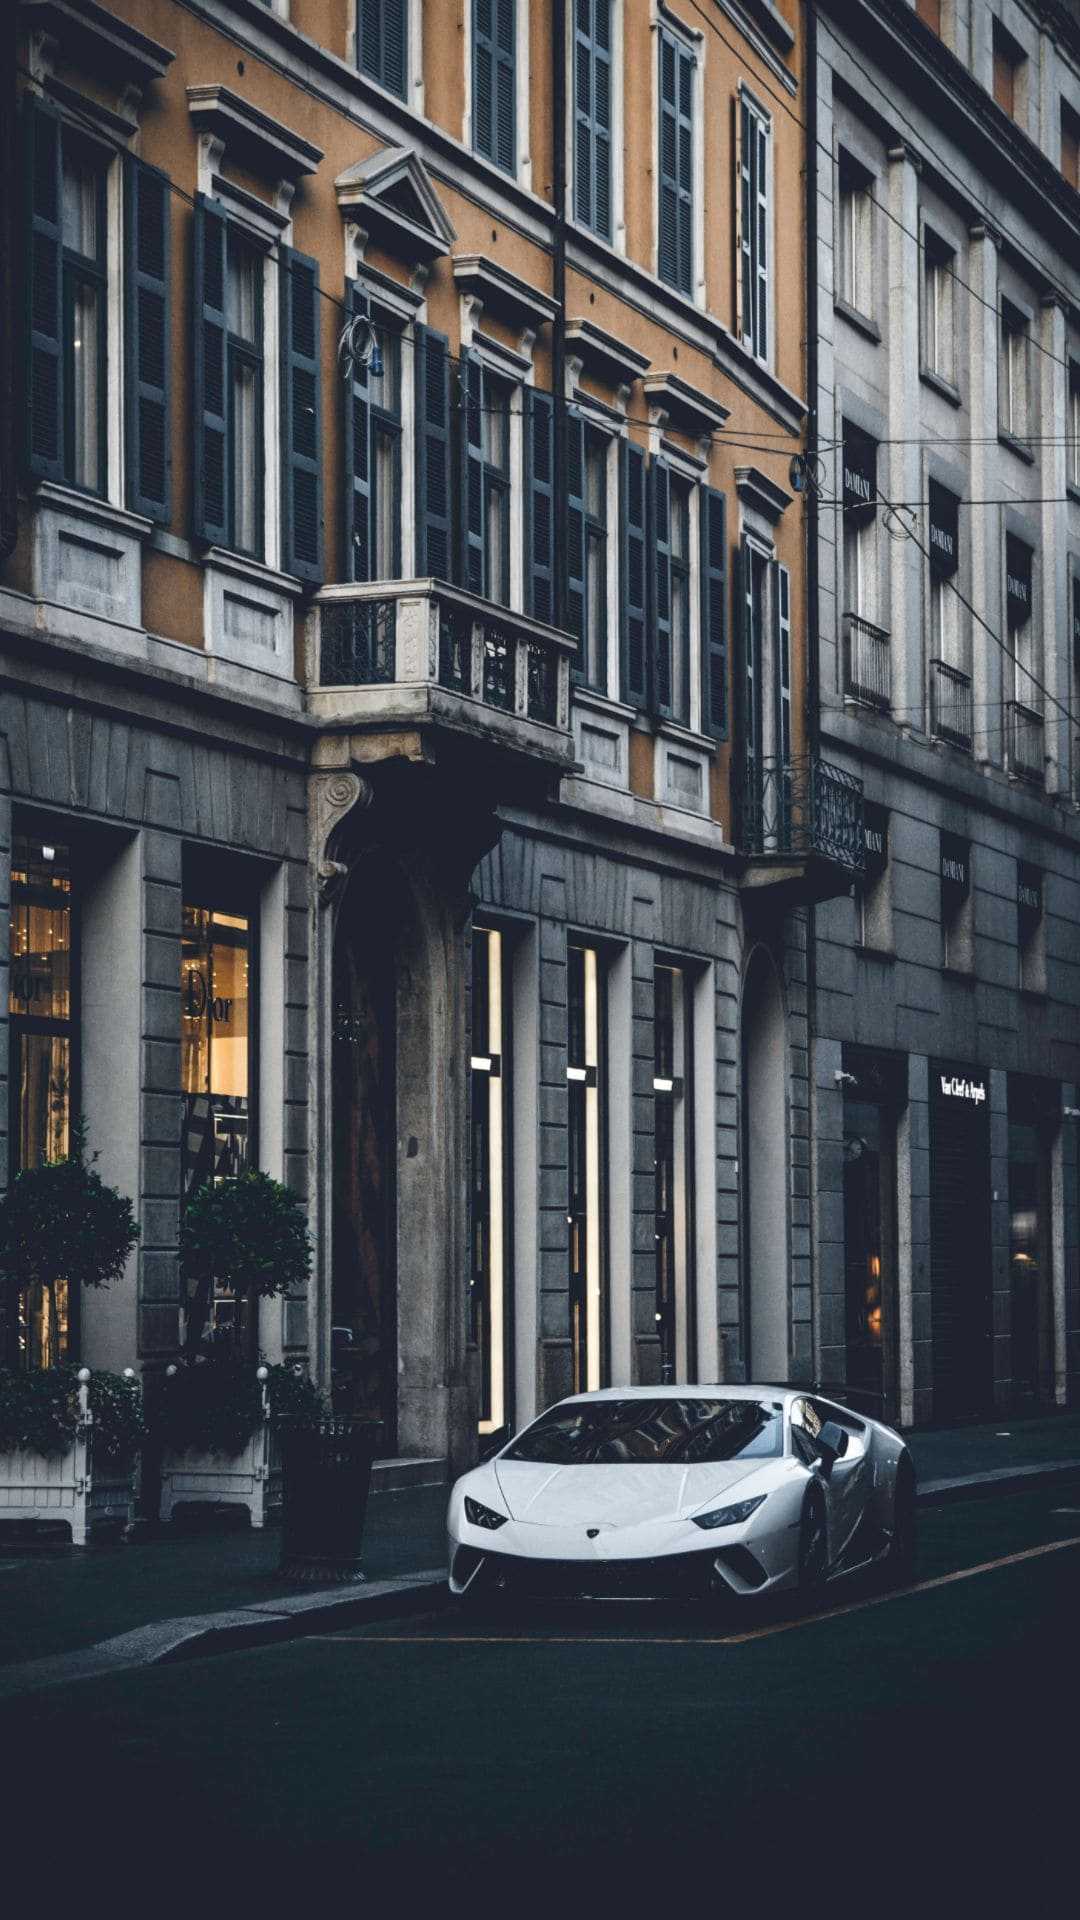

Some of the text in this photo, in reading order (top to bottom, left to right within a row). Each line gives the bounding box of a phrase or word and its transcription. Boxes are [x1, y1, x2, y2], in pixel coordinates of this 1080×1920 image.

[844, 467, 870, 502] DAMIANI
[930, 523, 953, 556] DAMIANI
[1007, 574, 1028, 602] DAMIANI
[942, 857, 964, 883] DAMIANI
[941, 1076, 951, 1096] Van
